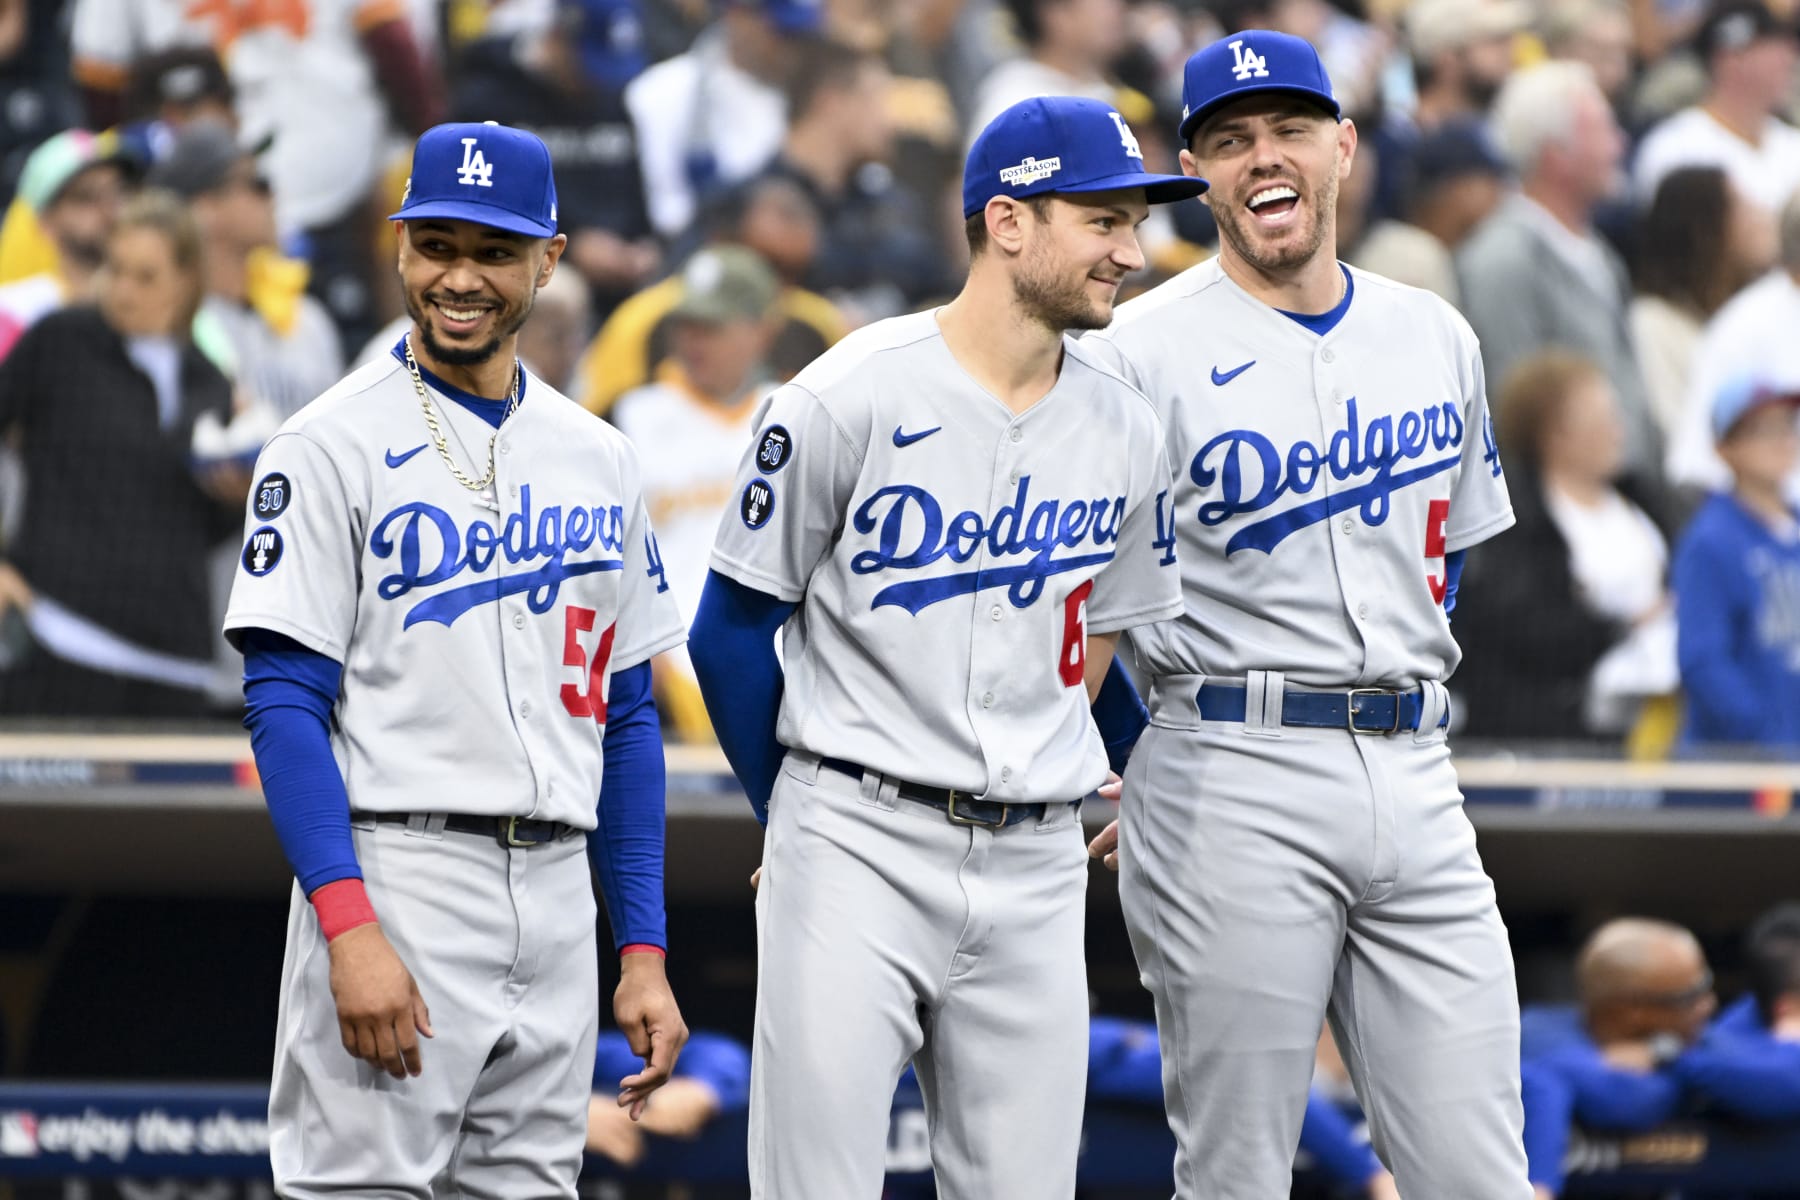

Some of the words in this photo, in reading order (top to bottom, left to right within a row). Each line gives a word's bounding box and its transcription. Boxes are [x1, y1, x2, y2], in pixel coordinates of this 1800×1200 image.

[1228, 40, 1269, 81] LA
[457, 138, 493, 187] LA
[1001, 160, 1058, 179] POSTSEASON
[761, 439, 783, 466] 30
[1190, 396, 1464, 527] Dodgers
[258, 487, 284, 512] 30
[750, 484, 769, 507] VIN
[253, 533, 275, 552] VIN
[1424, 499, 1450, 606] 5
[1058, 578, 1095, 688] 6
[39, 1106, 131, 1162] enjoy
[136, 1108, 195, 1154] the
